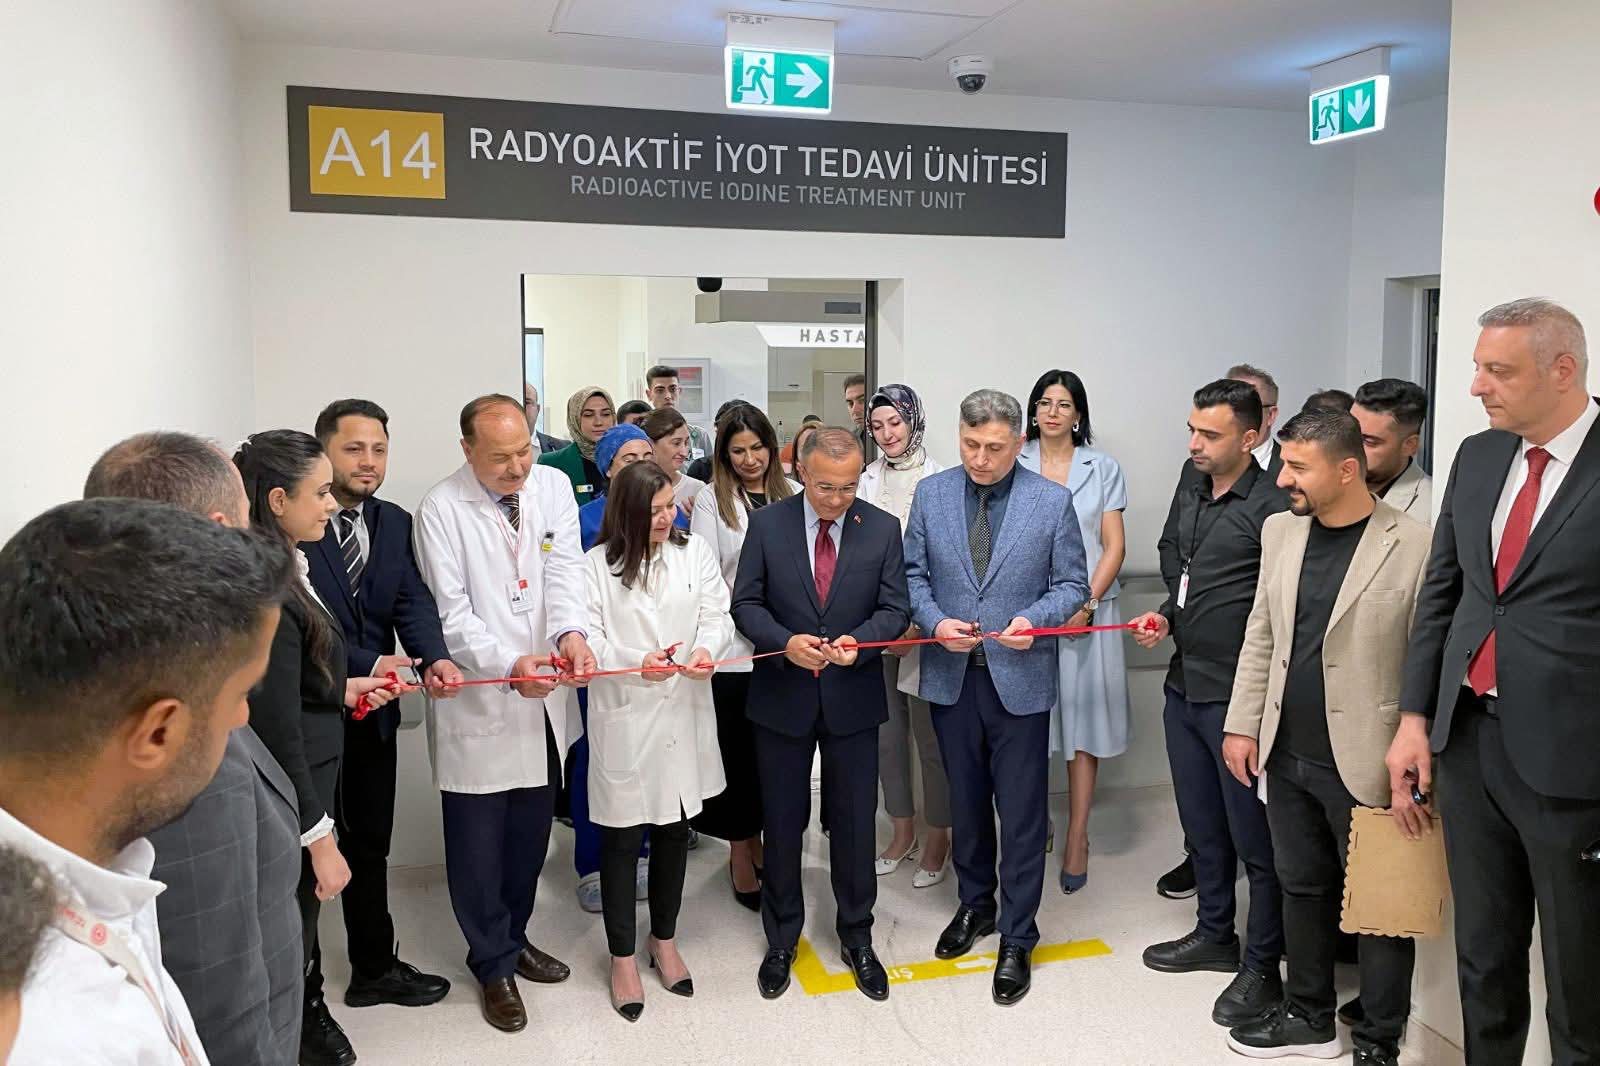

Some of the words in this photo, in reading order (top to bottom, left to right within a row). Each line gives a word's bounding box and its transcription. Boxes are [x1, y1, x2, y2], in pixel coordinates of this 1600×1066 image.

[319, 127, 437, 180] A14
[469, 127, 704, 171] RADYOAKTİF
[715, 134, 789, 177] İYOT
[797, 144, 912, 182] TEDAVİ
[924, 145, 1047, 187] ÜNİTESİ
[571, 174, 713, 201] RADIOACTIVE
[720, 181, 791, 204] IODINE
[795, 185, 916, 209] TREATMENT
[920, 190, 967, 211] UNIT
[800, 328, 865, 343] HASTA
